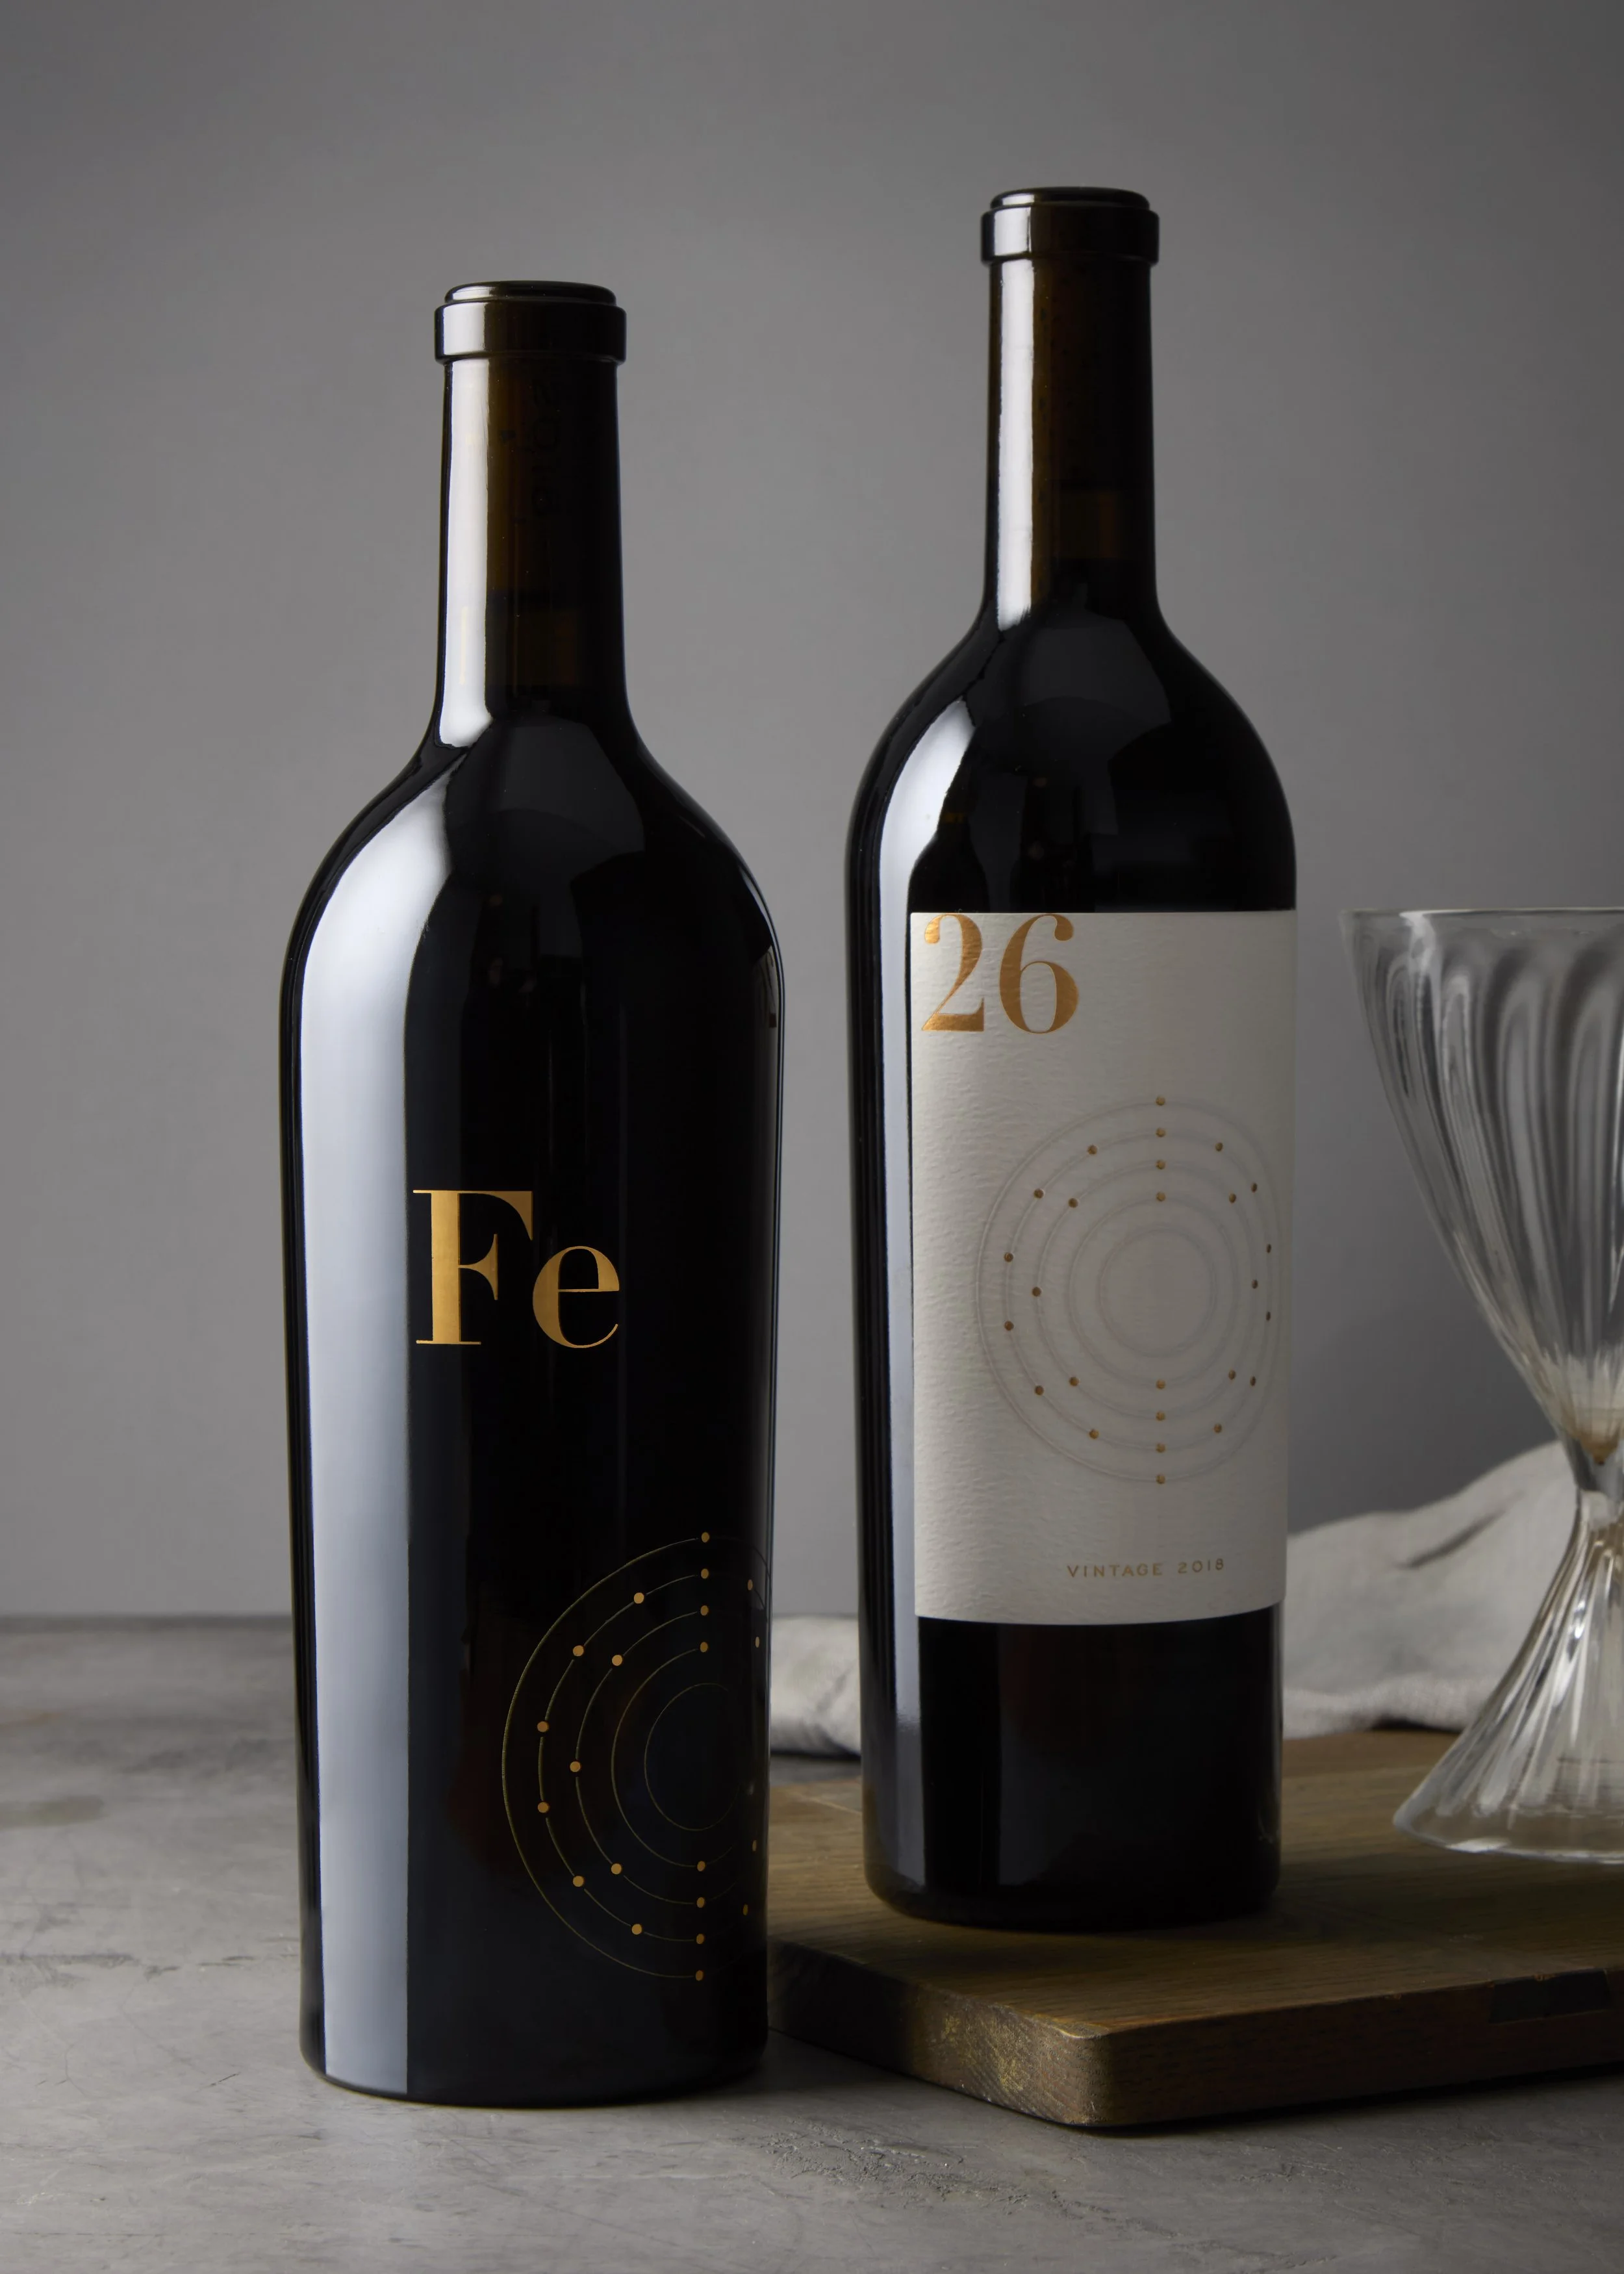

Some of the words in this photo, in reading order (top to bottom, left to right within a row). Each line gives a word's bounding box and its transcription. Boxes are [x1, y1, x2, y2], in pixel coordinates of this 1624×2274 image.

[922, 913, 1079, 1034] 26
[412, 1190, 620, 1349] Fe
[1067, 1563, 1163, 1578] VINTAGE
[1178, 1558, 1224, 1574] 2018
